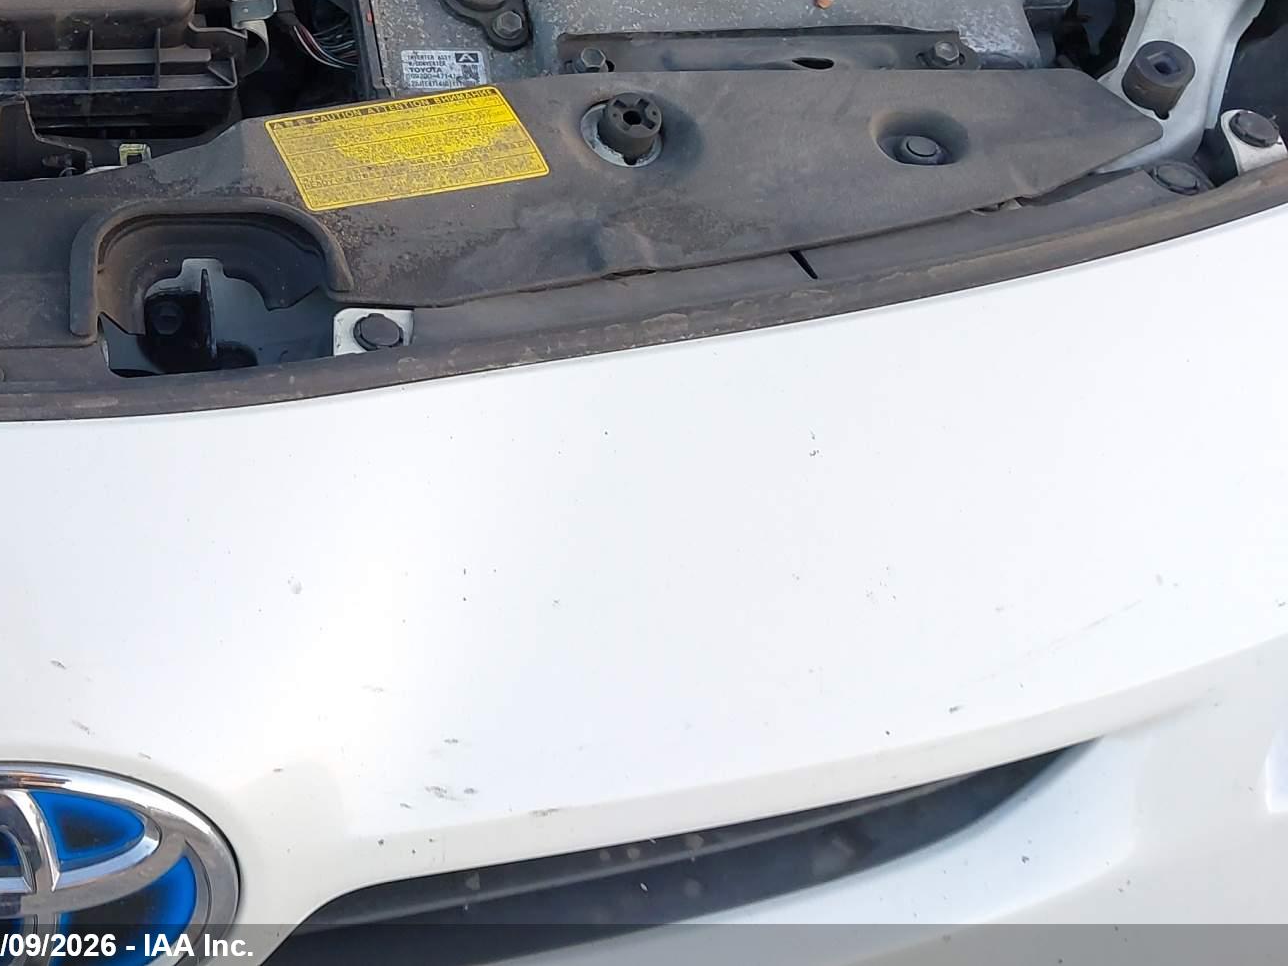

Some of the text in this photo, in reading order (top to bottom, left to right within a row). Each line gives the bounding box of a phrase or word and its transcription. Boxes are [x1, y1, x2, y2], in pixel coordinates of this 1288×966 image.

[436, 89, 493, 105] ВНИМАНИЕ
[311, 108, 362, 123] CAUTION
[367, 98, 431, 115] ATTENTION
